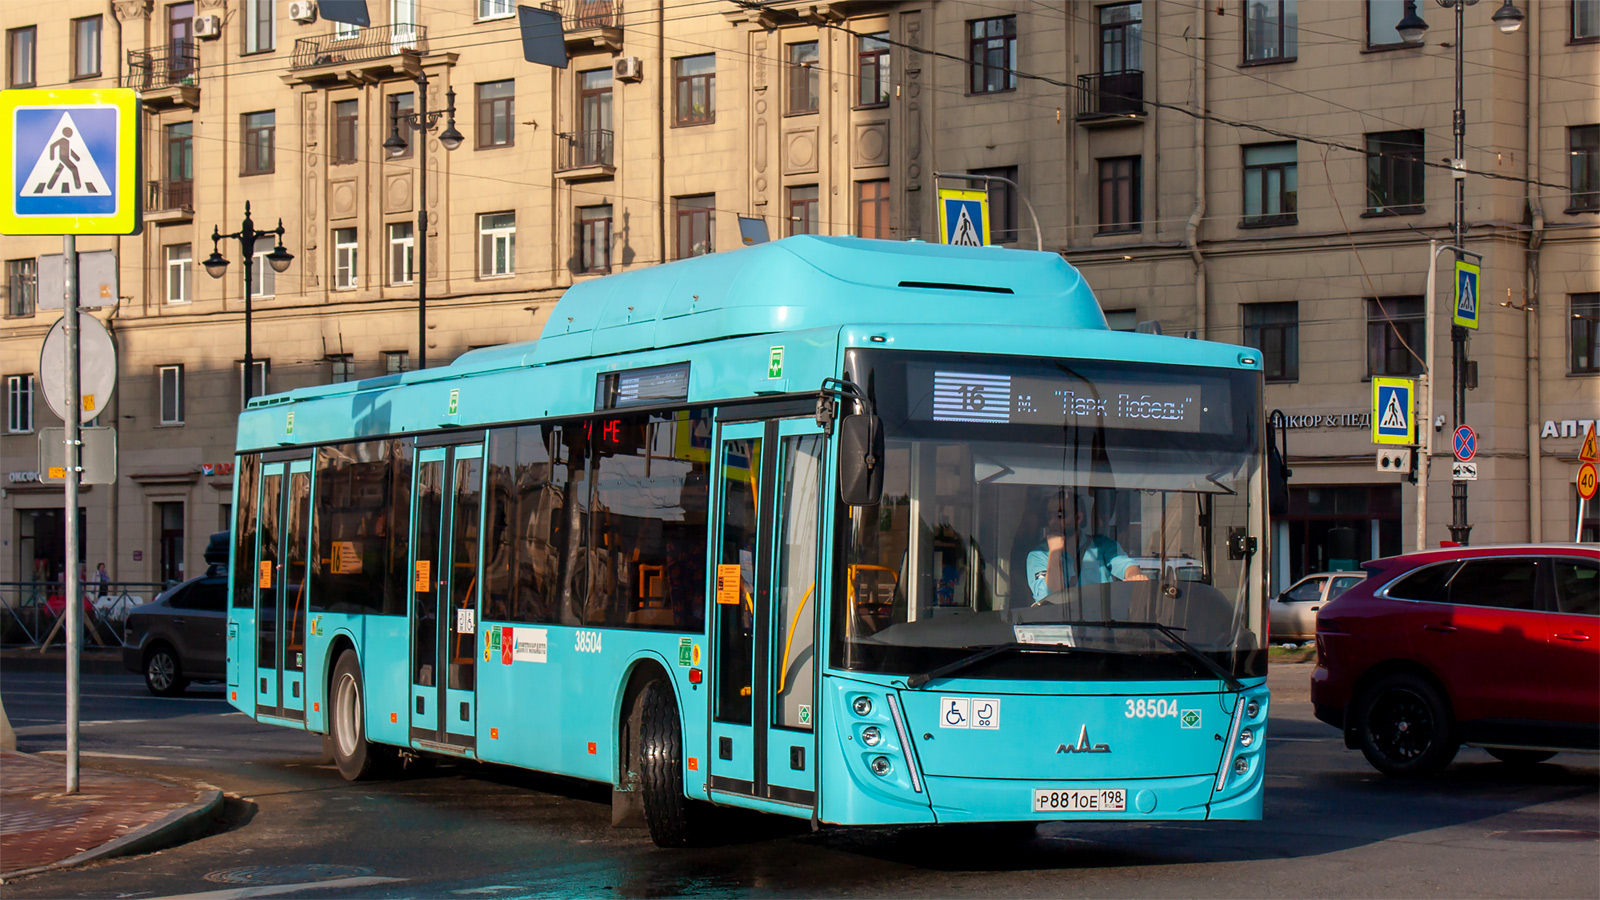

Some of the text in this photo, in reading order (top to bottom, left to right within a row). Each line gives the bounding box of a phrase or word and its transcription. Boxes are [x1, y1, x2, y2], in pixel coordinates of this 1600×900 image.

[958, 384, 985, 411] 16
[1054, 390, 1107, 417] "Парк
[1118, 393, 1192, 420] Победы"
[1325, 413, 1337, 427] &
[1541, 420, 1600, 438] АПТ
[1581, 473, 1594, 488] 40
[574, 630, 602, 653] 38504
[1124, 698, 1178, 718] 38504
[1101, 790, 1123, 804] 198
